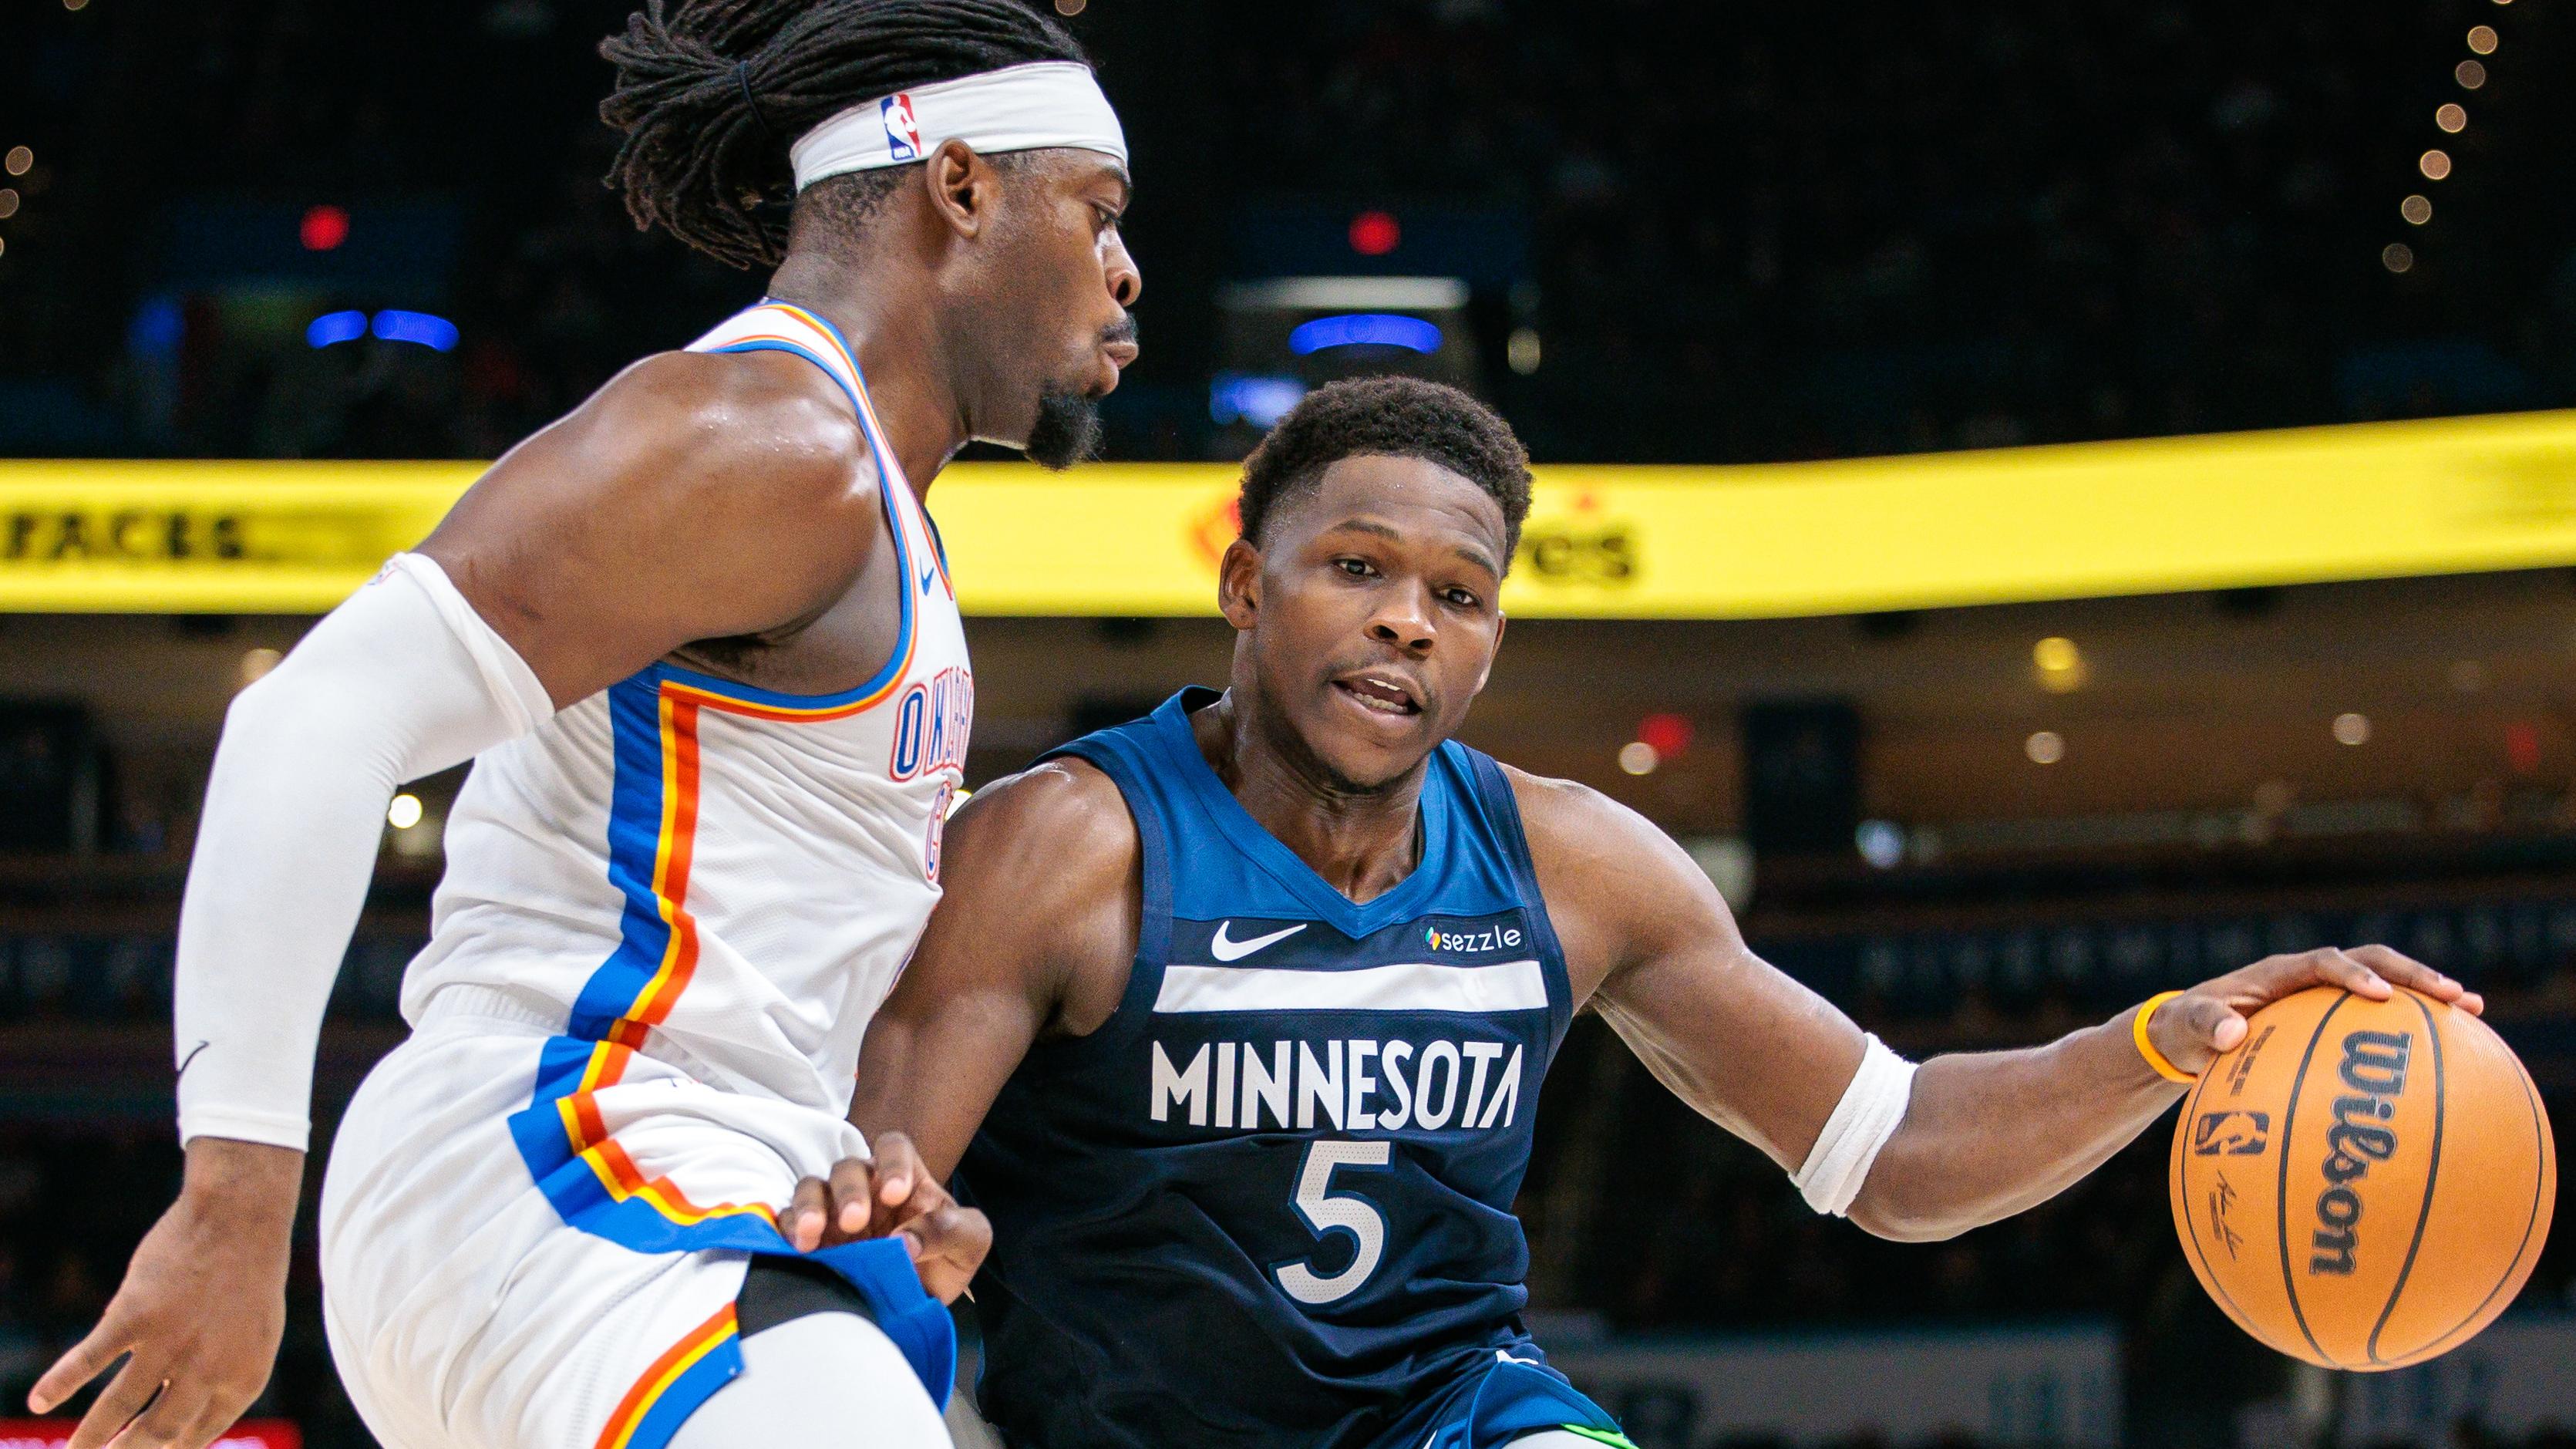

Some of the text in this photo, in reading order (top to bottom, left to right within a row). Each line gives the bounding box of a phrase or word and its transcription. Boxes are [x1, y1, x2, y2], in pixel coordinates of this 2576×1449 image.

[1441, 925, 1521, 952] sezzle
[1150, 1039, 1523, 1131] MINNESOTA
[2308, 1029, 2413, 1277] Wilson
[1275, 1140, 1392, 1305] 5
